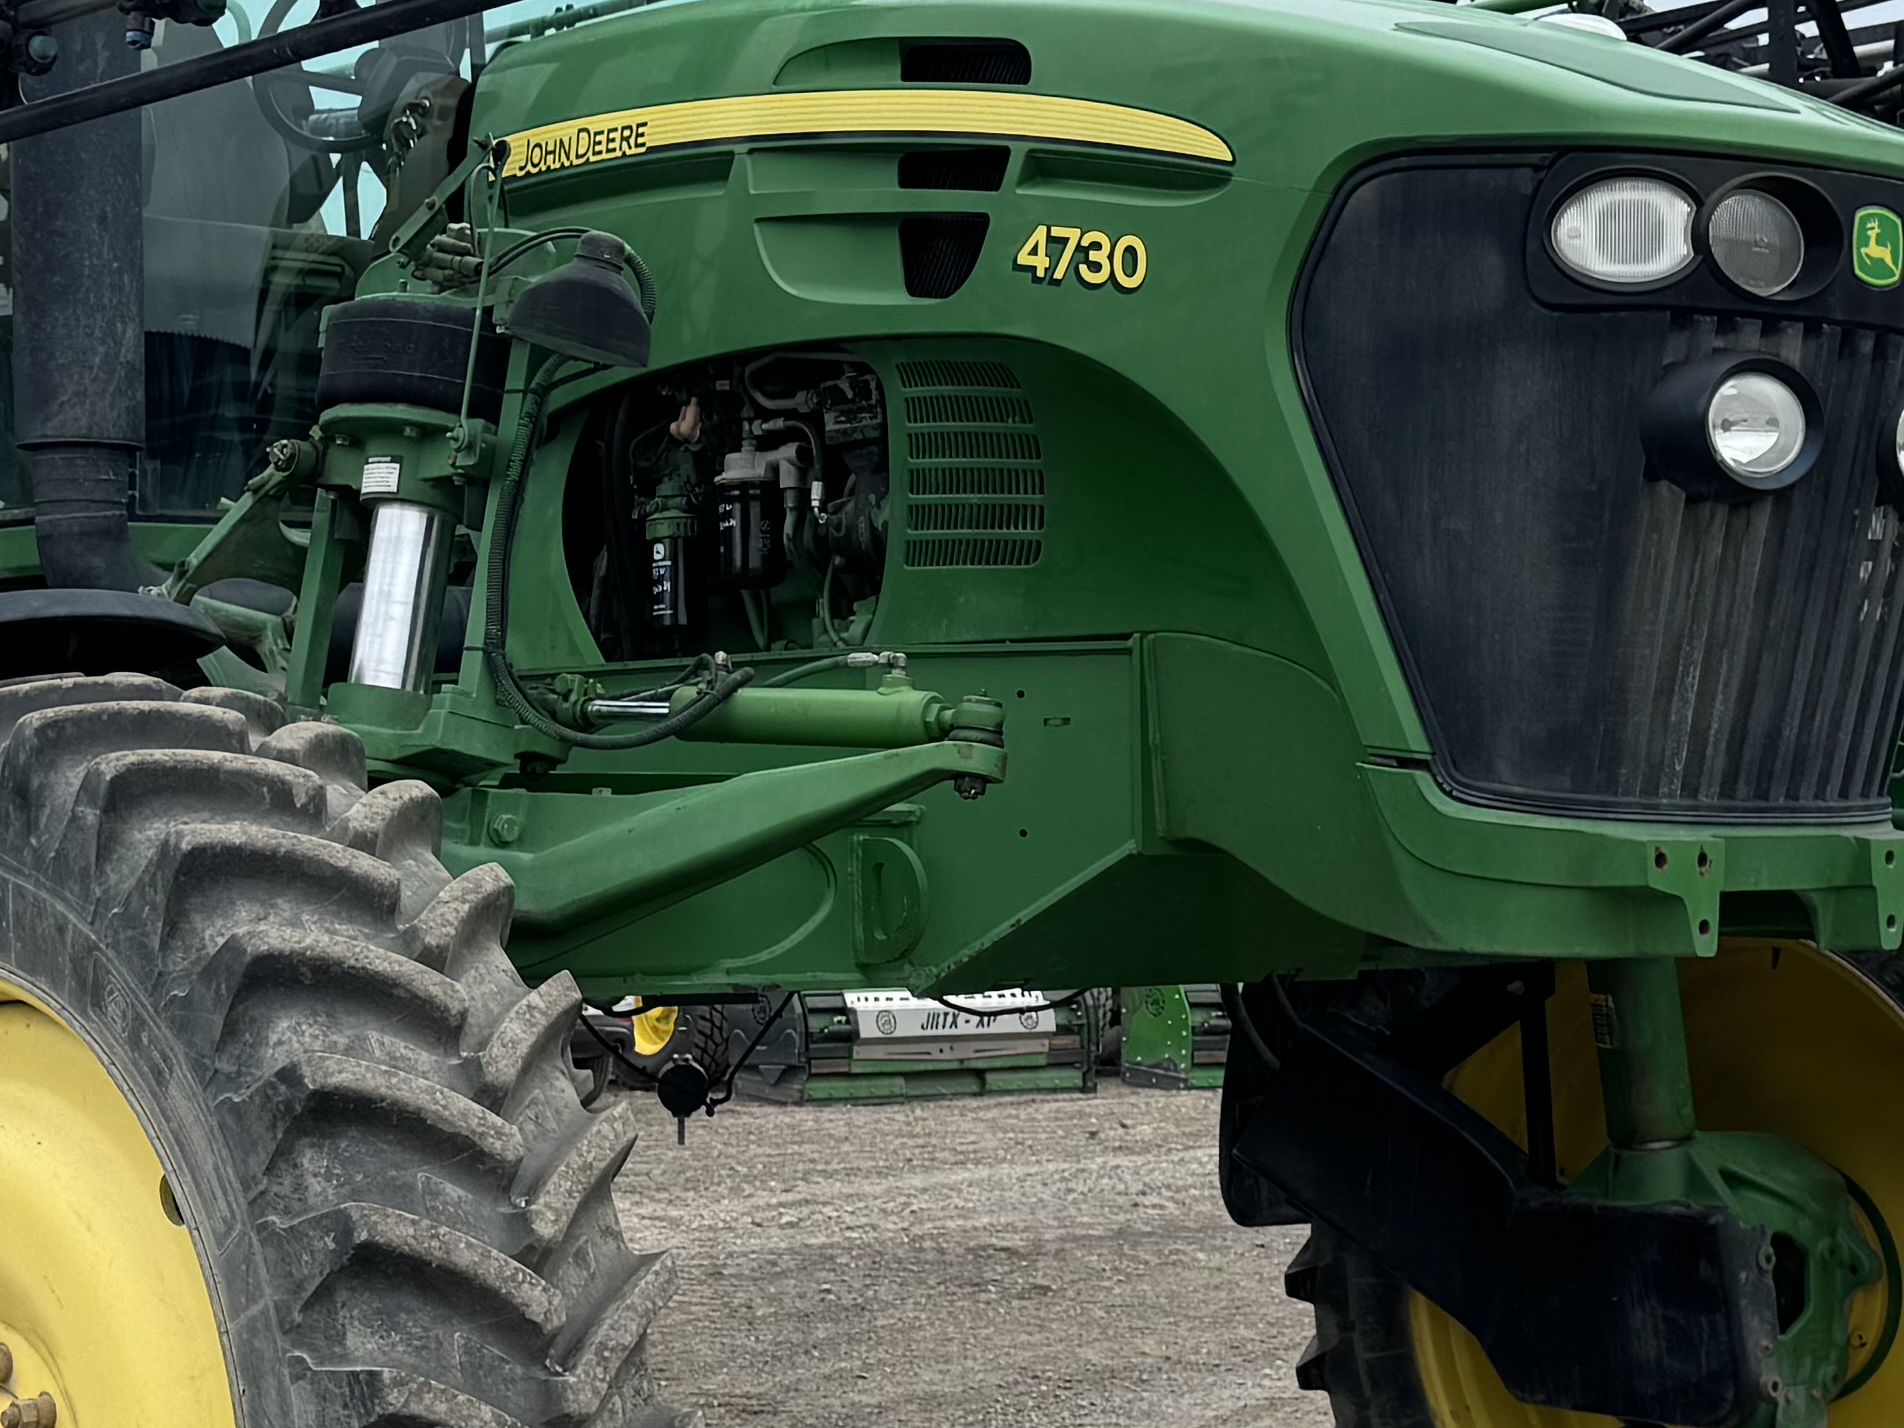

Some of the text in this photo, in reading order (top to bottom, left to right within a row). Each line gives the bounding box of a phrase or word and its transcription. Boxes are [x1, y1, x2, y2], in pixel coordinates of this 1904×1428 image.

[517, 121, 649, 173] JOHN DEERE
[1014, 224, 1148, 291] 4730
